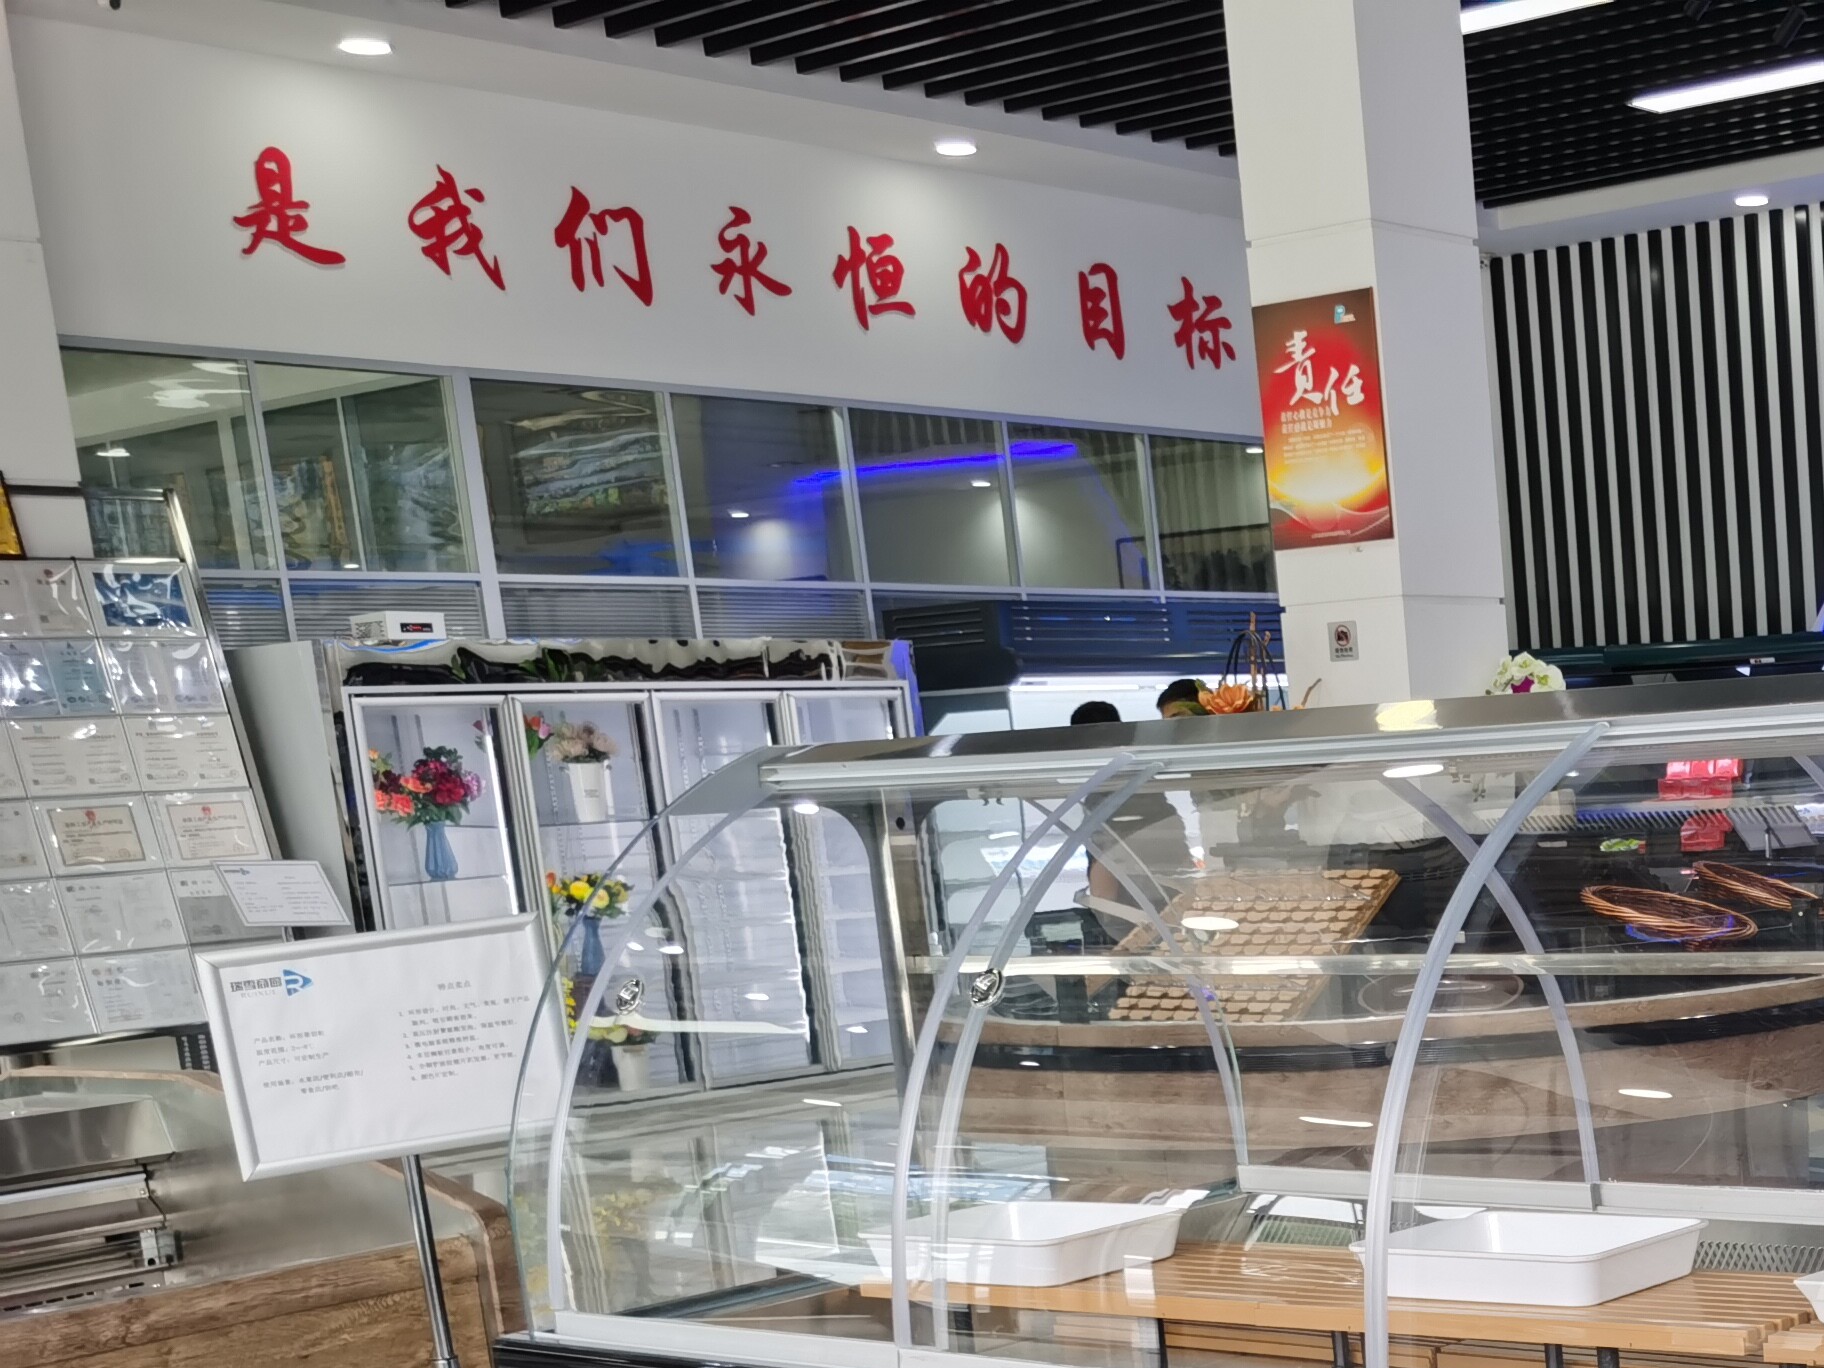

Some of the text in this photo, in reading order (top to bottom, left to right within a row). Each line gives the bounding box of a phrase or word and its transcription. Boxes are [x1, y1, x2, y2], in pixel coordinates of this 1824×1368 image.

[235, 147, 1237, 368] 是我们永恒的目标
